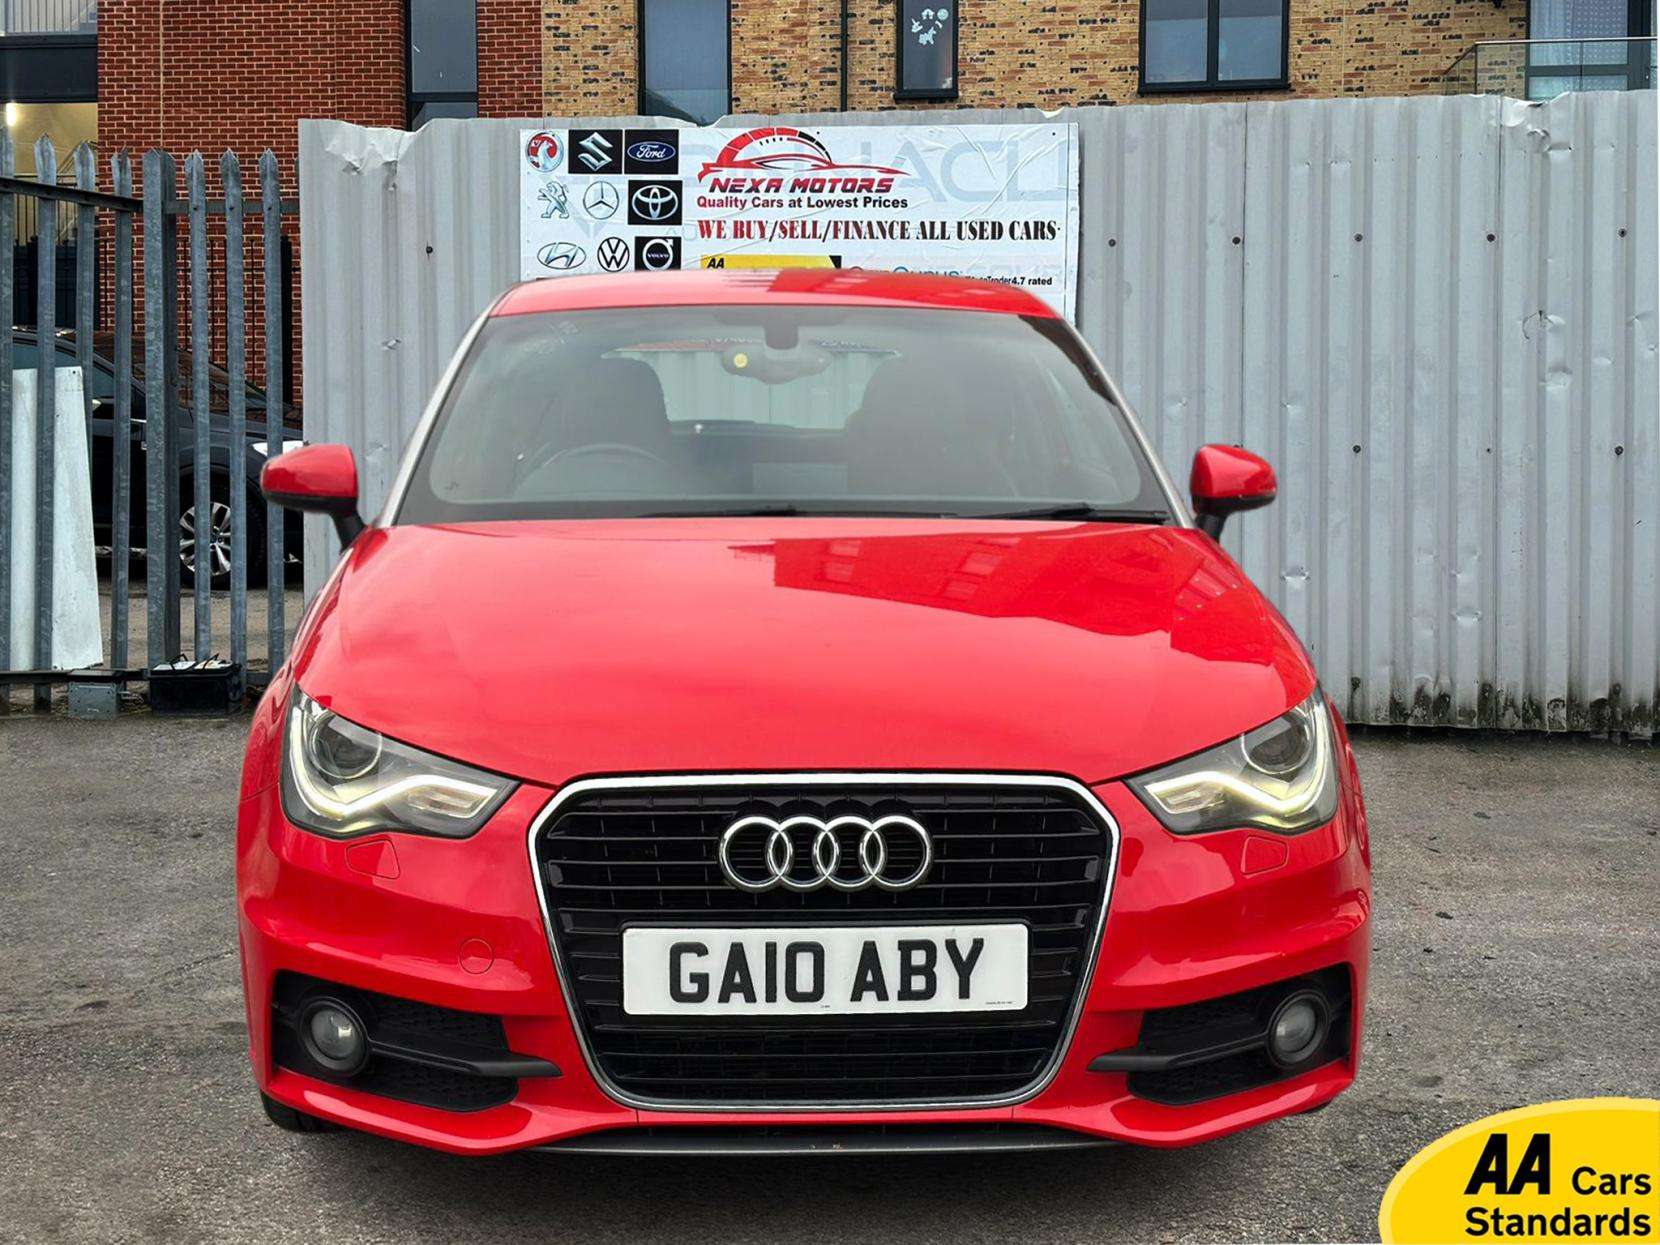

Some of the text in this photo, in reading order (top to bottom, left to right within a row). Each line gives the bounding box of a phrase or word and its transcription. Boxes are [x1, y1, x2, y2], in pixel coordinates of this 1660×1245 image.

[636, 144, 666, 159] Ford
[709, 178, 894, 193] NEXA MOTORS
[697, 196, 908, 210] Quality Cars at Lowest Prices
[697, 220, 726, 239] WE
[733, 219, 910, 243] BUY/SELL/FINANCE
[916, 220, 951, 240] ALL
[957, 220, 1004, 240] USED
[1009, 220, 1057, 240] CARS
[707, 257, 725, 269] AA
[1028, 277, 1052, 285] rated
[850, 938, 984, 1002] ABY
